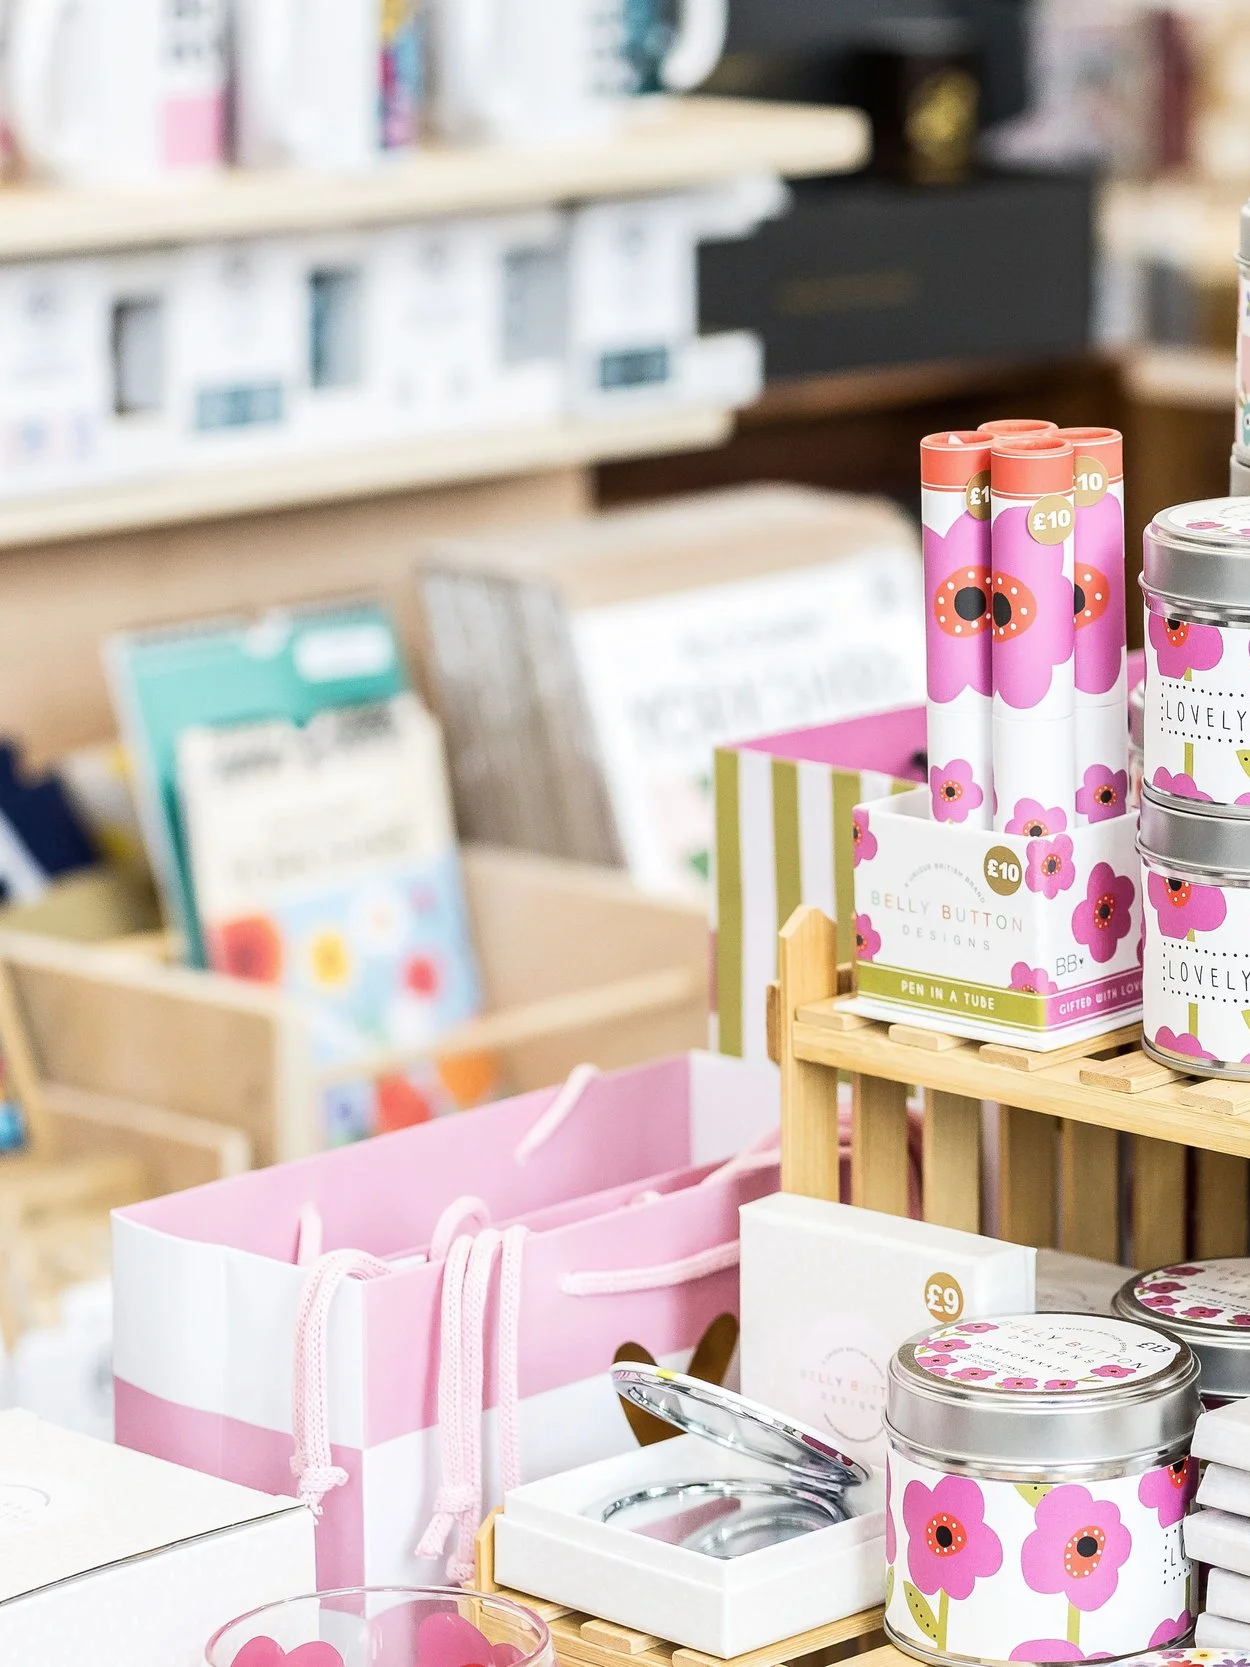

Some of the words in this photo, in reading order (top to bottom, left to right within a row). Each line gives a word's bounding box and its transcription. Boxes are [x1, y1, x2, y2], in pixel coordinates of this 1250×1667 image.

[970, 485, 991, 505] £1
[1032, 509, 1071, 531] £10
[1166, 699, 1247, 731] LOVELY
[987, 859, 1020, 883] £10
[871, 890, 929, 915] BELLY
[942, 904, 1023, 933] BUTTON
[902, 924, 991, 951] DESIGNS
[1168, 960, 1250, 992] LOVELY
[901, 980, 924, 996] PEN
[930, 986, 944, 1000] IN
[949, 990, 958, 1003] A
[964, 992, 995, 1010] TUBE
[1059, 996, 1092, 1015] GIFTED
[1095, 989, 1118, 1004] WITH
[1121, 981, 1143, 996] LOV
[927, 1284, 959, 1315] £9
[974, 1341, 1070, 1373] POMEGRANATE
[997, 1320, 1063, 1341] BELLY
[1064, 1341, 1149, 1369] BUTTON
[1007, 1335, 1096, 1364] DESIGNS
[1135, 1341, 1171, 1353] £13
[851, 1379, 887, 1398] BUTT
